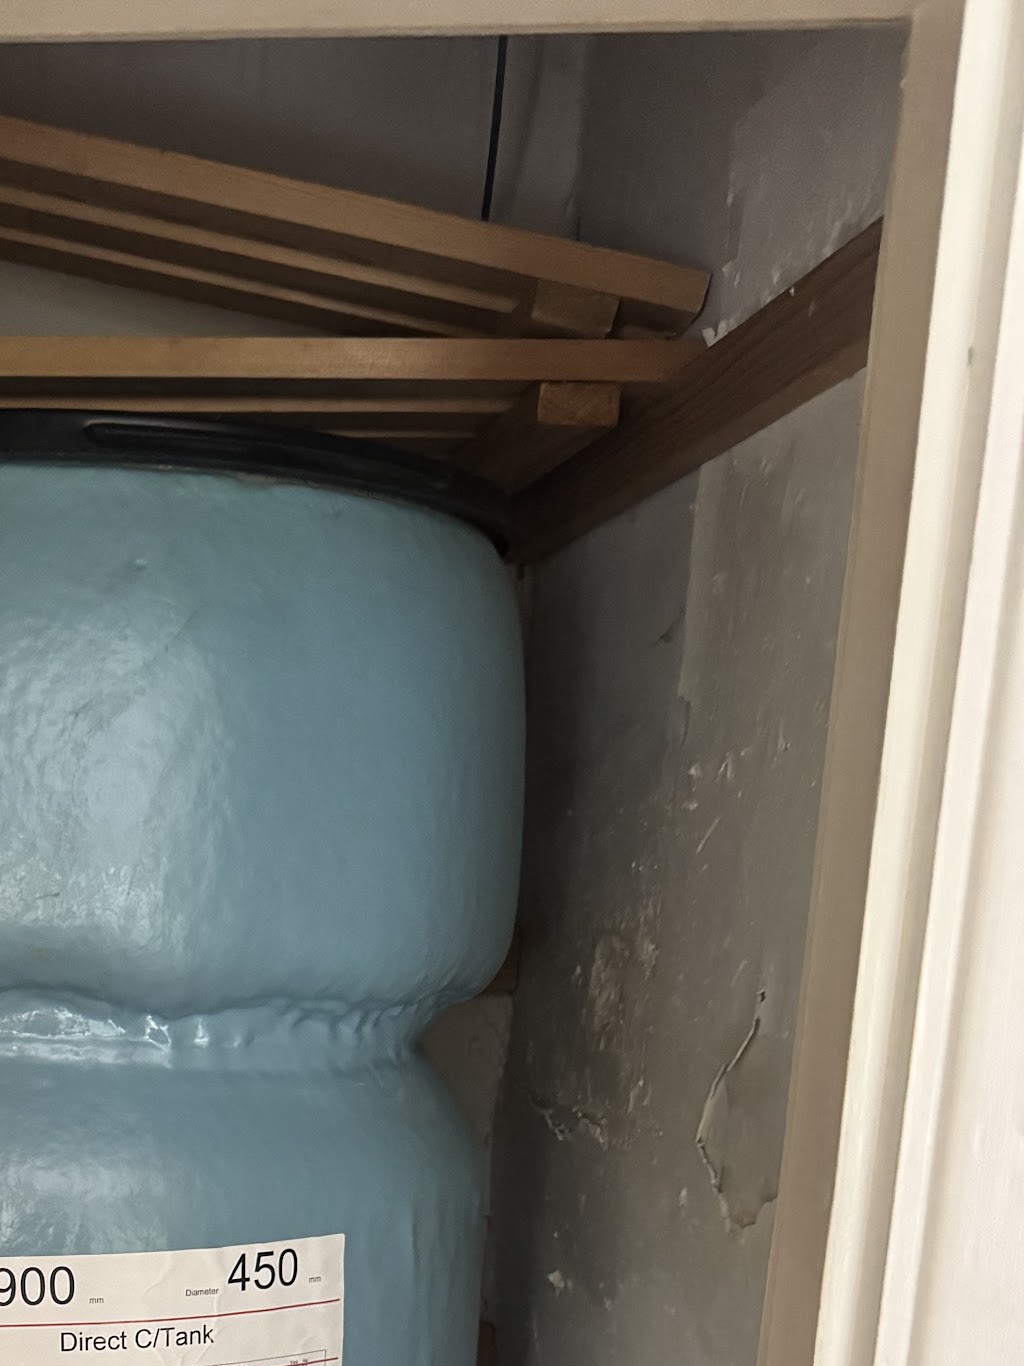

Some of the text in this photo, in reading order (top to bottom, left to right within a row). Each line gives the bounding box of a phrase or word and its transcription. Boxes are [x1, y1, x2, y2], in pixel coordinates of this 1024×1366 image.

[185, 1248, 321, 1297] Diameter 450 mm
[61, 1325, 214, 1352] Direct C/Tank
